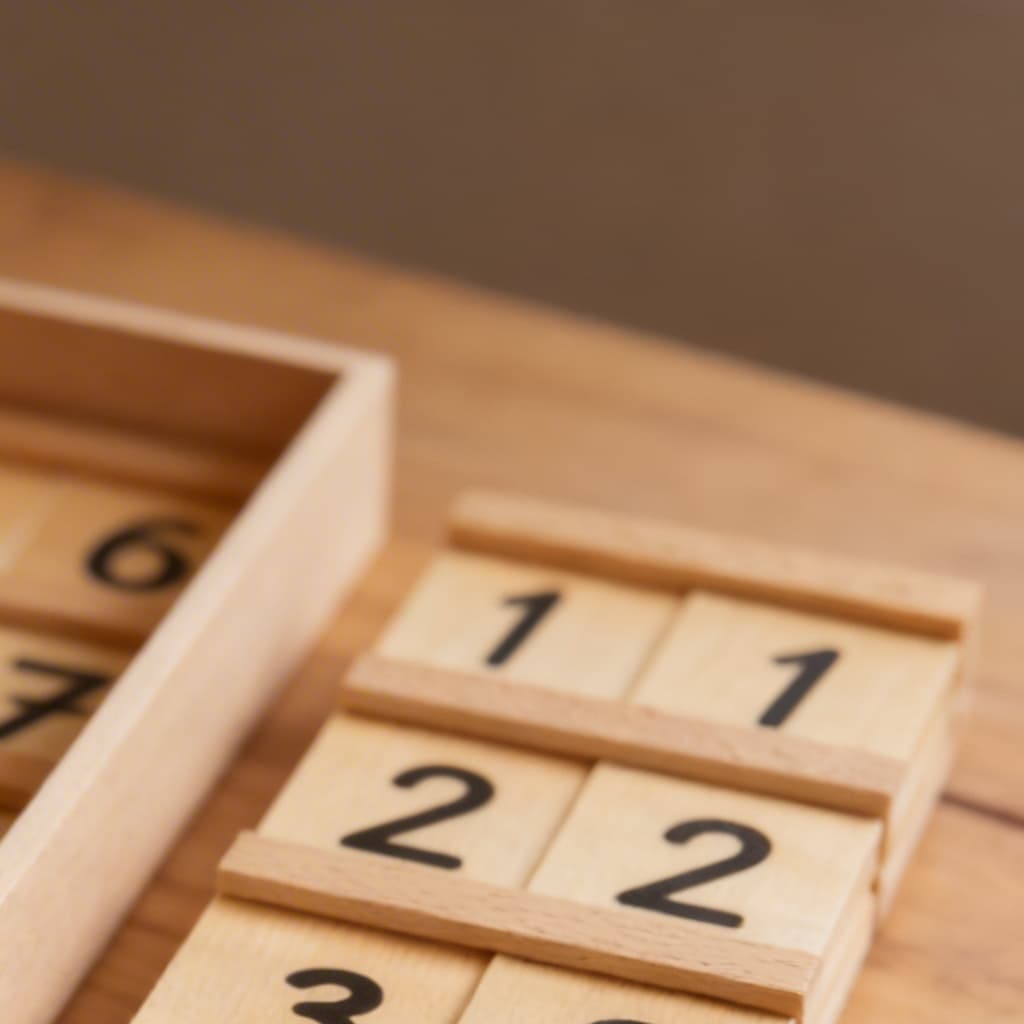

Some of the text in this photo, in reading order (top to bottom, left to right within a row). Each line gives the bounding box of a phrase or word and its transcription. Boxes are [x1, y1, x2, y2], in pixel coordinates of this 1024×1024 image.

[85, 518, 201, 592] 6
[483, 590, 838, 728] 1 1
[341, 765, 771, 928] 2 2
